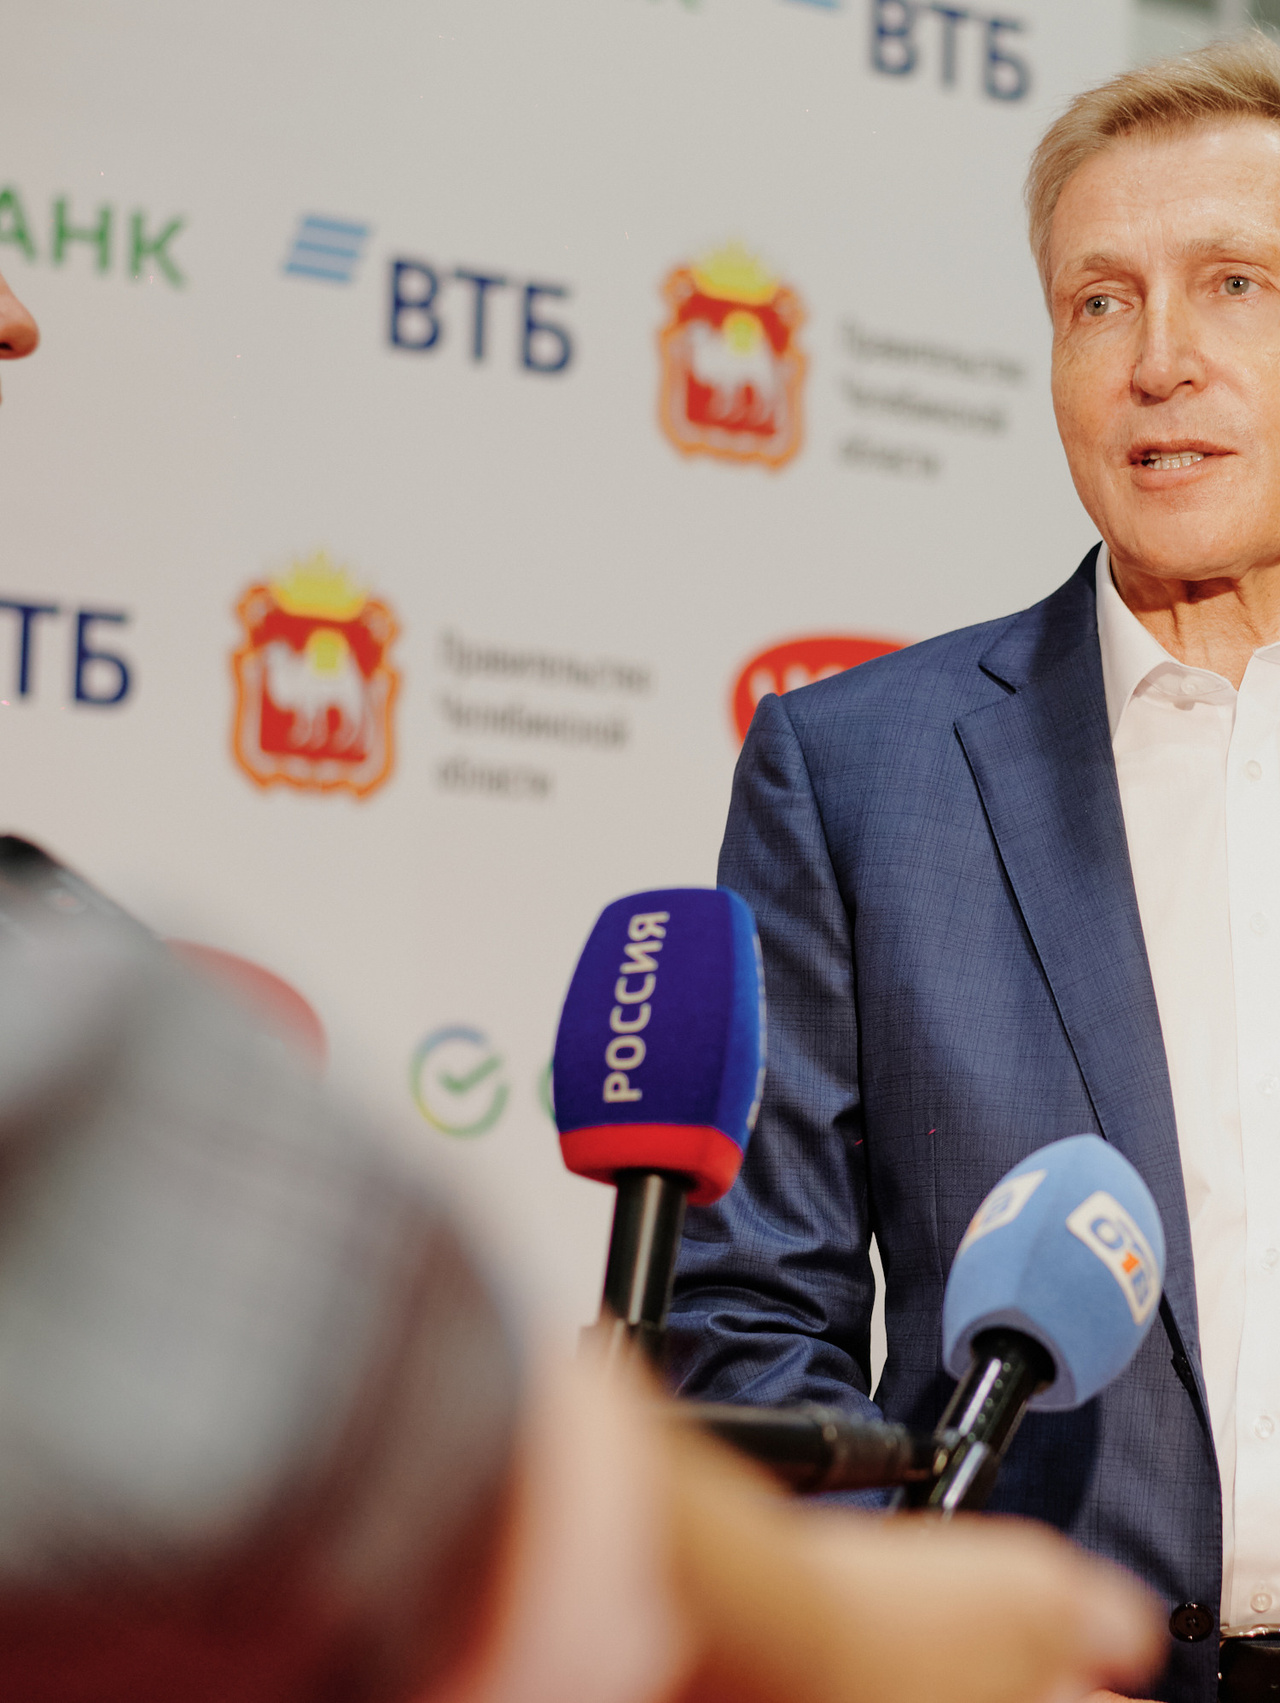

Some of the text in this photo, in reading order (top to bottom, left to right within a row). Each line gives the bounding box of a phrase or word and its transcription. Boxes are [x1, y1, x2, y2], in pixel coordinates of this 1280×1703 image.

[871, 0, 1032, 103] ВТБ
[388, 257, 573, 375] ВТБ
[0, 599, 132, 707] ТБ
[602, 910, 671, 1103] РОССИЯ
